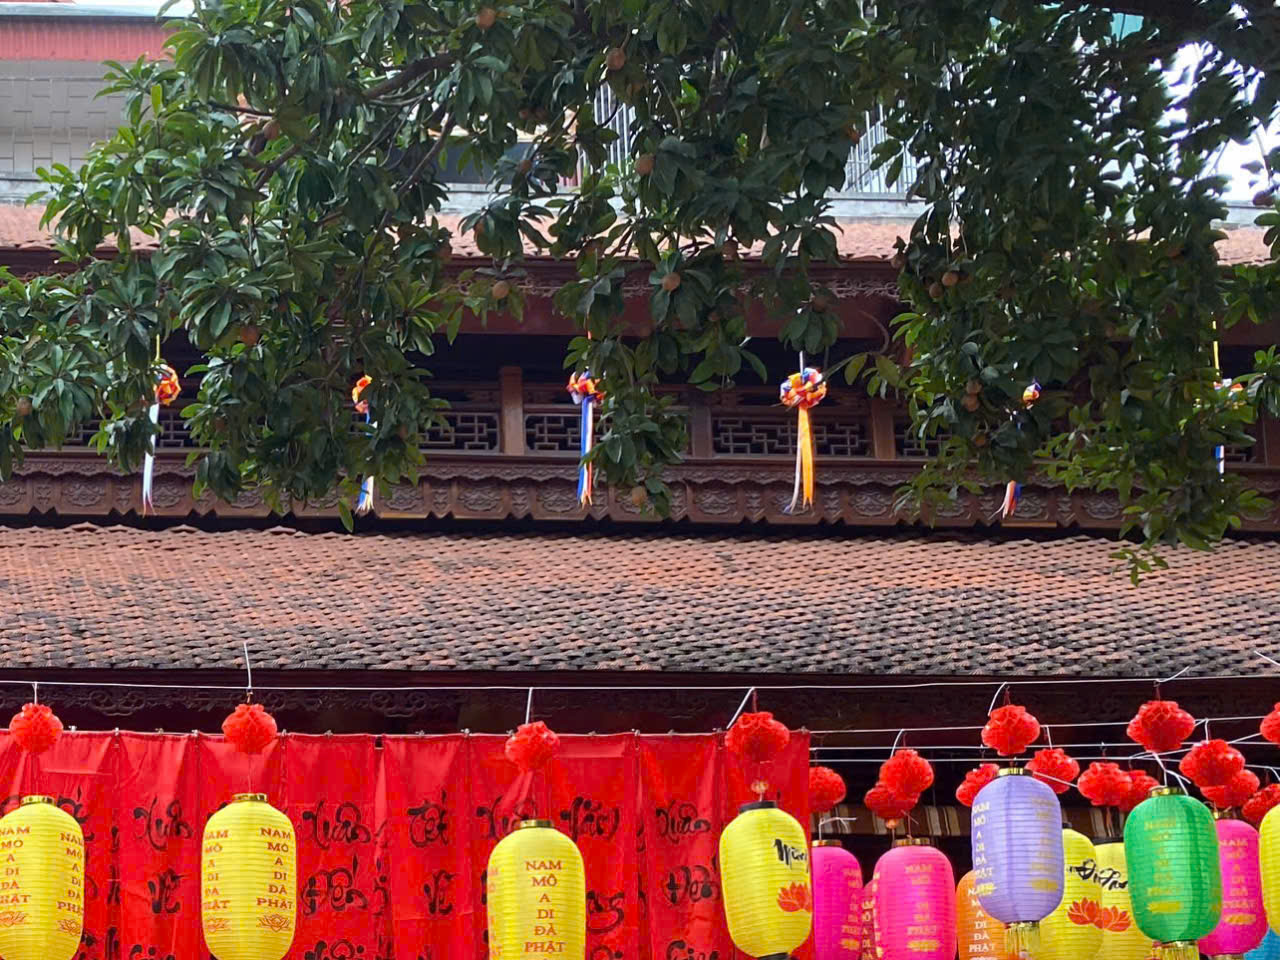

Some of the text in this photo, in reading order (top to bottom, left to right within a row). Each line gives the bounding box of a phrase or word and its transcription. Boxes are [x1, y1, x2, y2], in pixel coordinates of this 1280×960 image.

[260, 827, 292, 840] NAM
[274, 857, 284, 867] A
[273, 871, 288, 882] DI
[523, 860, 568, 954] NAM MÔ A DI ĐÀ PHẬT
[974, 921, 989, 930] DI
